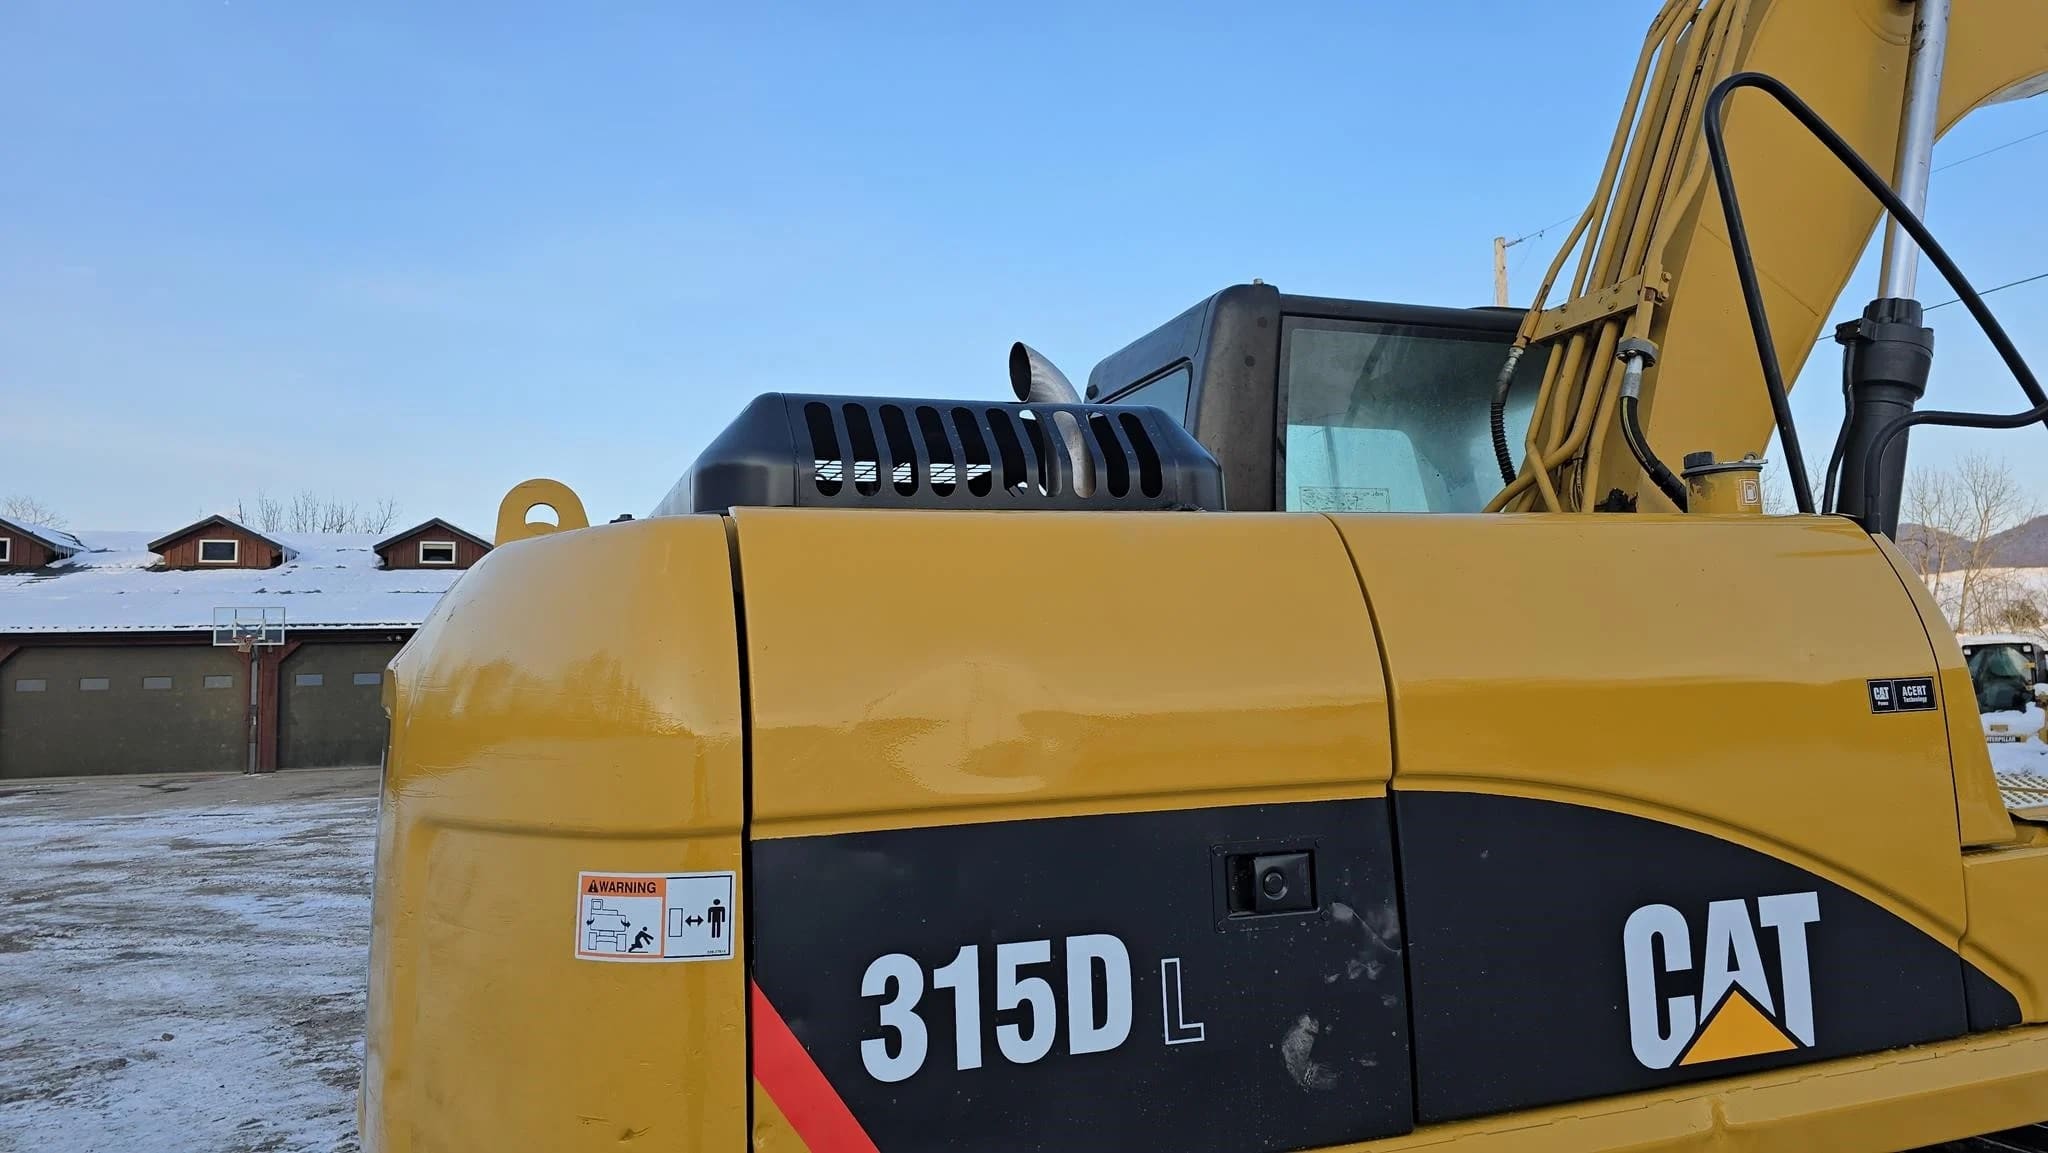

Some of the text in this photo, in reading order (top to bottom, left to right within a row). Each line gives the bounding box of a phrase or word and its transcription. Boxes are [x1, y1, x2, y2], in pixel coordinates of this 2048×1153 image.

[1873, 687, 1889, 700] CAT
[1902, 686, 1927, 697] ACERT
[599, 881, 656, 894] WARNING
[1623, 891, 1821, 1070] CAT
[860, 933, 1206, 1083] 315D L
